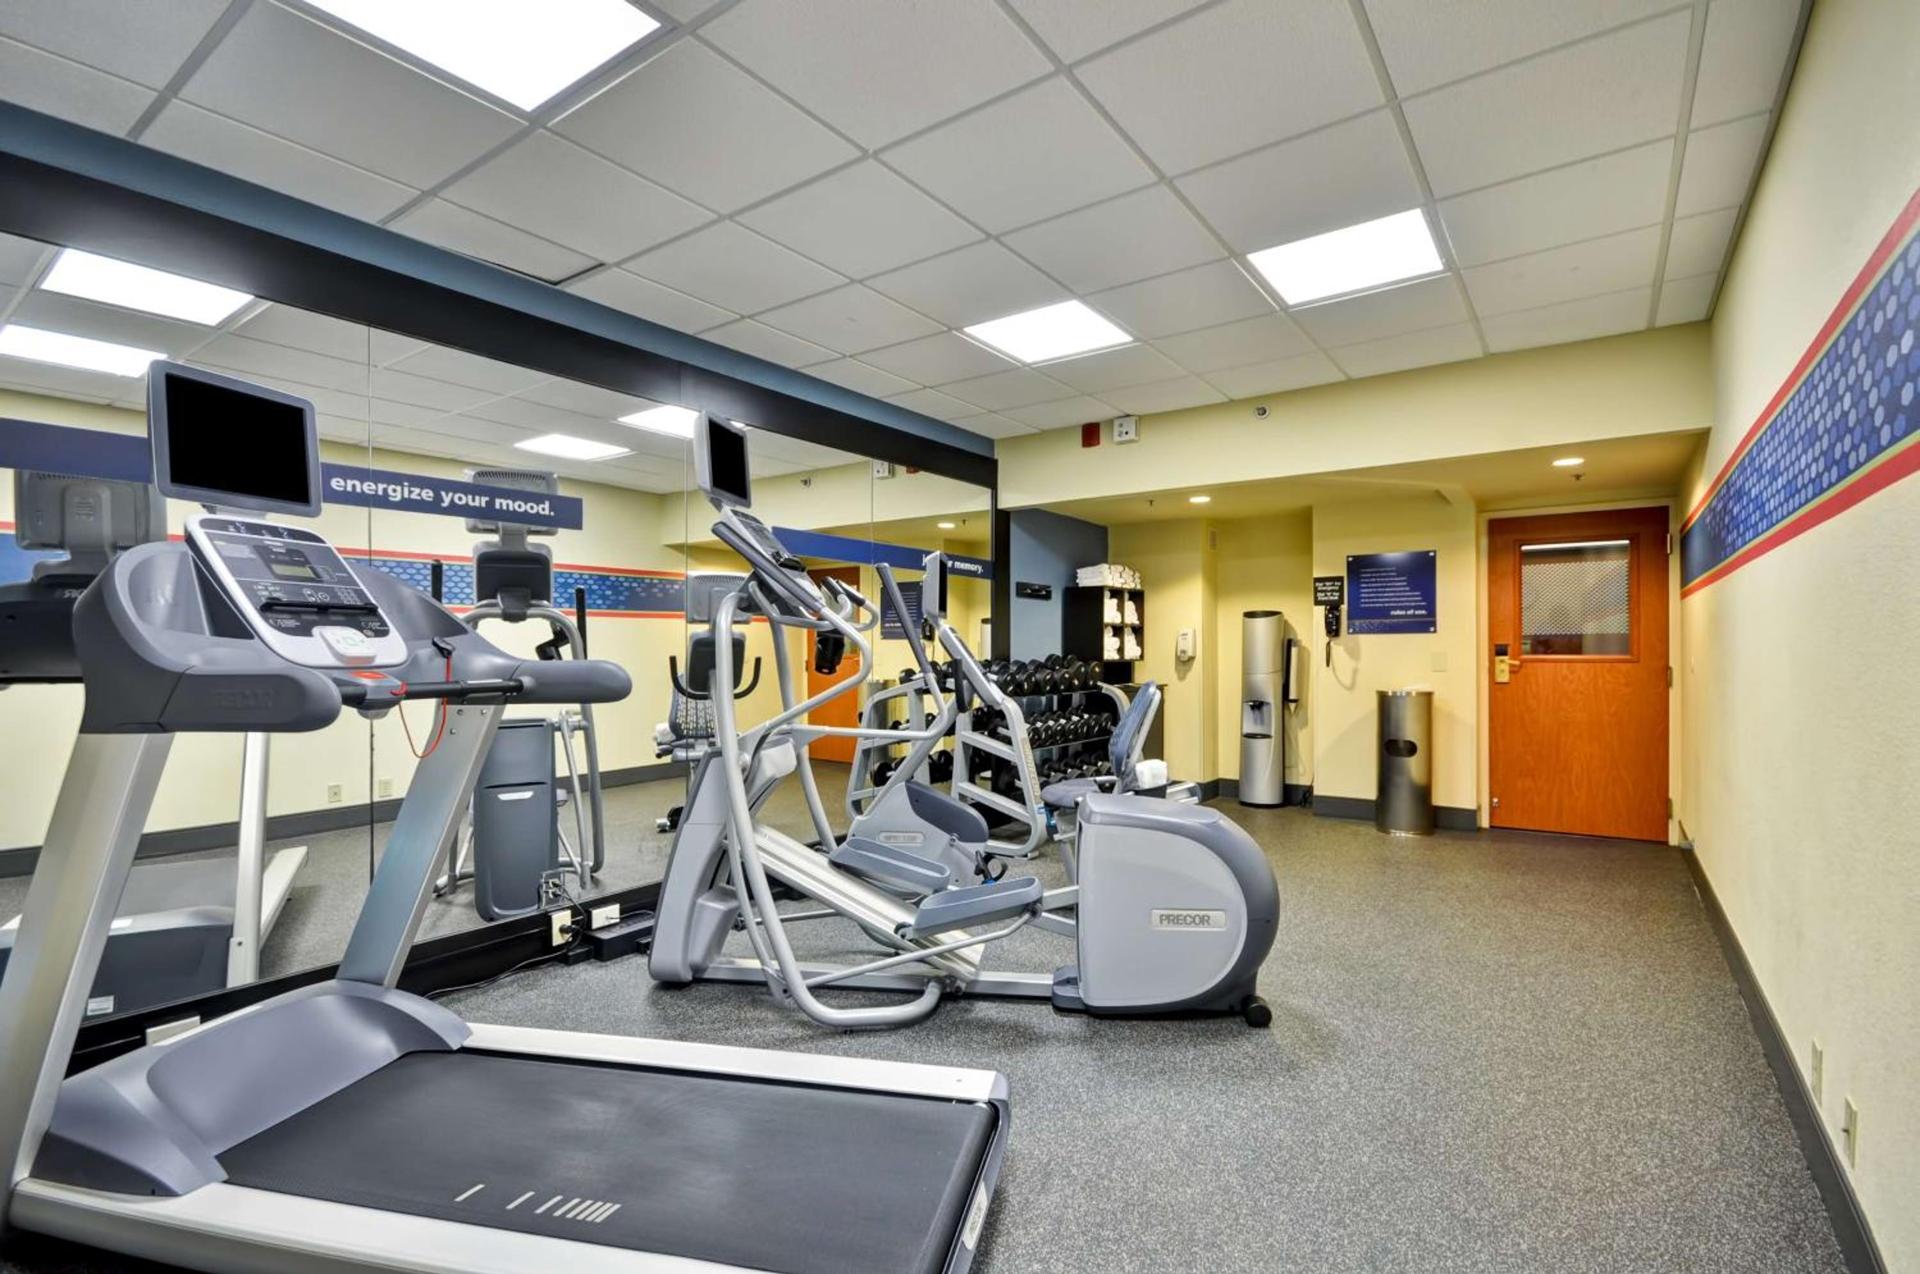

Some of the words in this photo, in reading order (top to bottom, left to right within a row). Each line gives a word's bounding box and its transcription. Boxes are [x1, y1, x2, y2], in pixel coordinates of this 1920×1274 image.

[330, 476, 434, 501] energize
[440, 490, 489, 507] your
[494, 498, 555, 516] mood.
[954, 561, 984, 573] memory.
[1159, 914, 1210, 925] PRECOR
